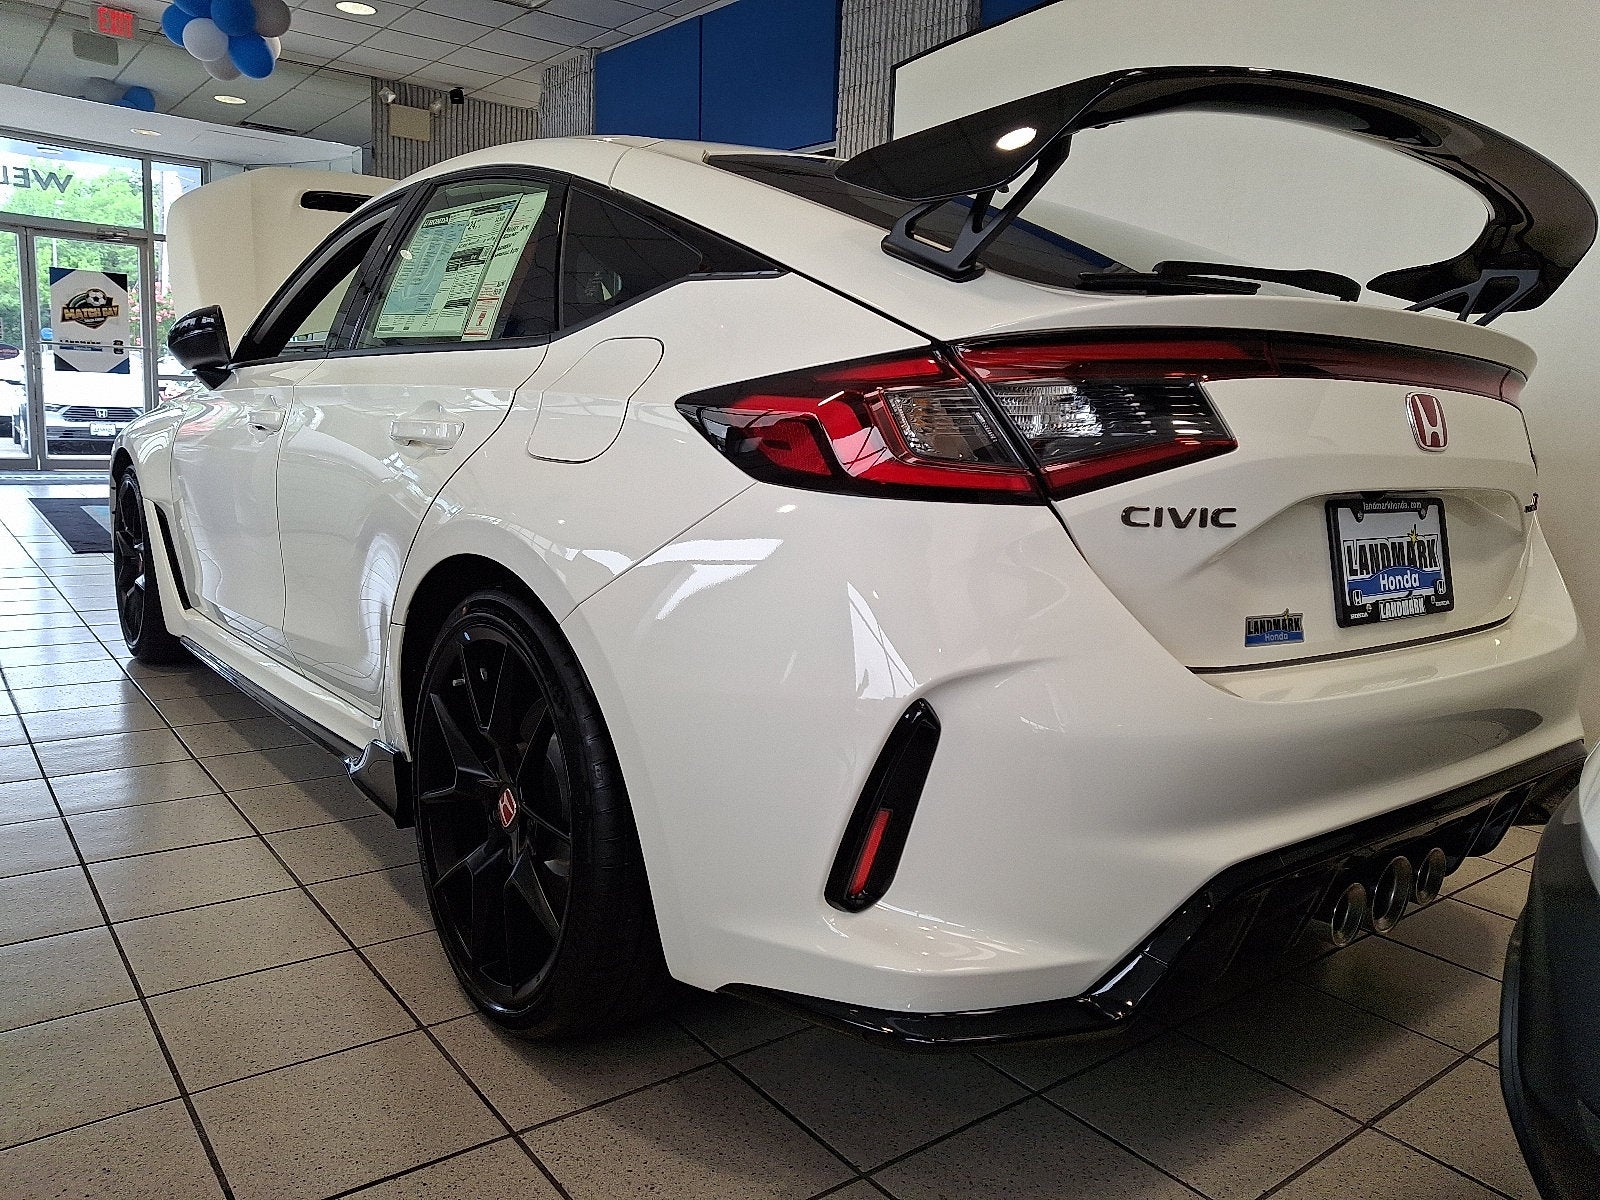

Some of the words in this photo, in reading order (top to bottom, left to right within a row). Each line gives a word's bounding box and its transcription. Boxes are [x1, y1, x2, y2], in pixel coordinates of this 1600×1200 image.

[97, 6, 134, 39] EXIT
[64, 308, 102, 320] MATCH
[101, 306, 119, 317] DAY
[1121, 506, 1237, 529] CIVIC
[1344, 537, 1440, 578] LANDMARK
[1380, 570, 1420, 592] Honda
[1380, 597, 1426, 619] LANDMARK
[1247, 617, 1301, 636] LANDMARK
[1264, 632, 1289, 642] Honda
